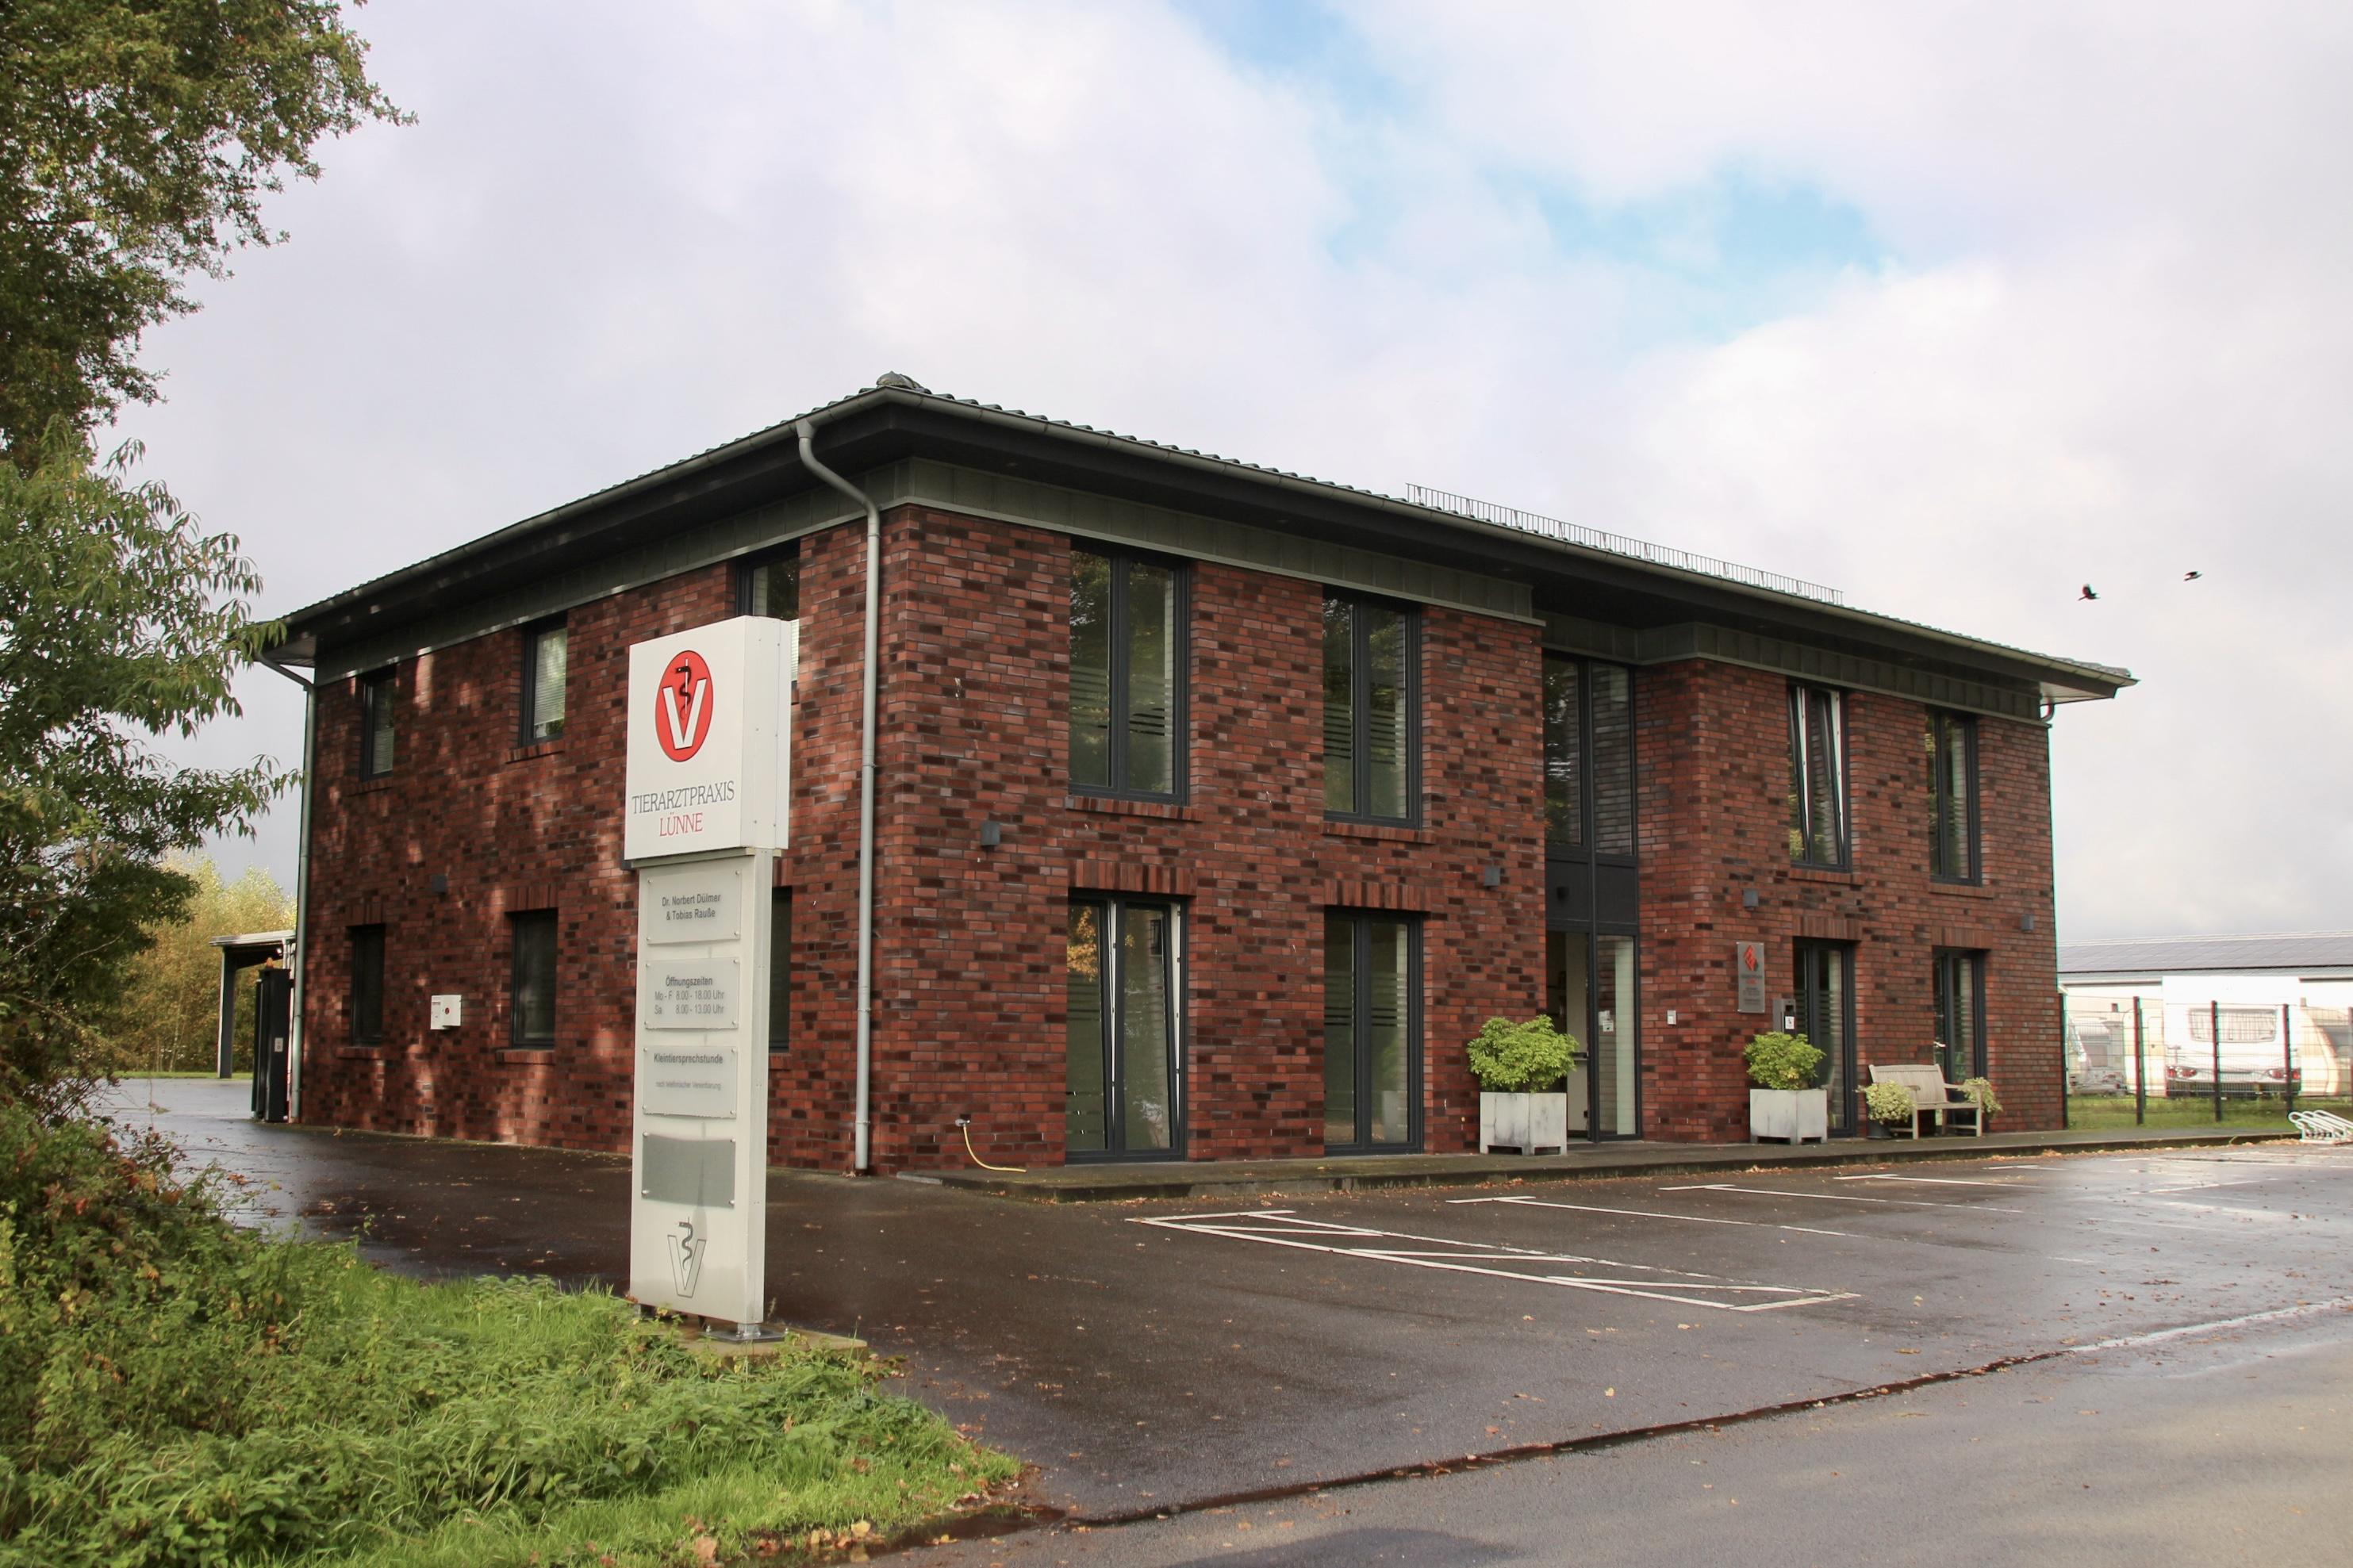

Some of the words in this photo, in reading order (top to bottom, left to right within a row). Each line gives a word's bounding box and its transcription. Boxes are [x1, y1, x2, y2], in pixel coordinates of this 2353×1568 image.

[662, 678, 707, 749] V
[631, 780, 735, 815] TIERARZTPRAXIS
[659, 811, 704, 837] LÜNNE
[662, 896, 670, 907] Dr.
[672, 895, 695, 906] Norbert
[697, 893, 721, 904] Dülmer
[666, 911, 671, 921] &
[672, 910, 693, 920] Tobias
[666, 974, 713, 988] Öffnungszeiten
[654, 991, 663, 1001] Mo
[694, 990, 712, 1000] 18.00
[712, 989, 724, 1000] Uhr
[654, 1004, 662, 1015] Sa
[712, 1004, 724, 1014] Uhr
[654, 1053, 724, 1066] Kleintiersprechstunde
